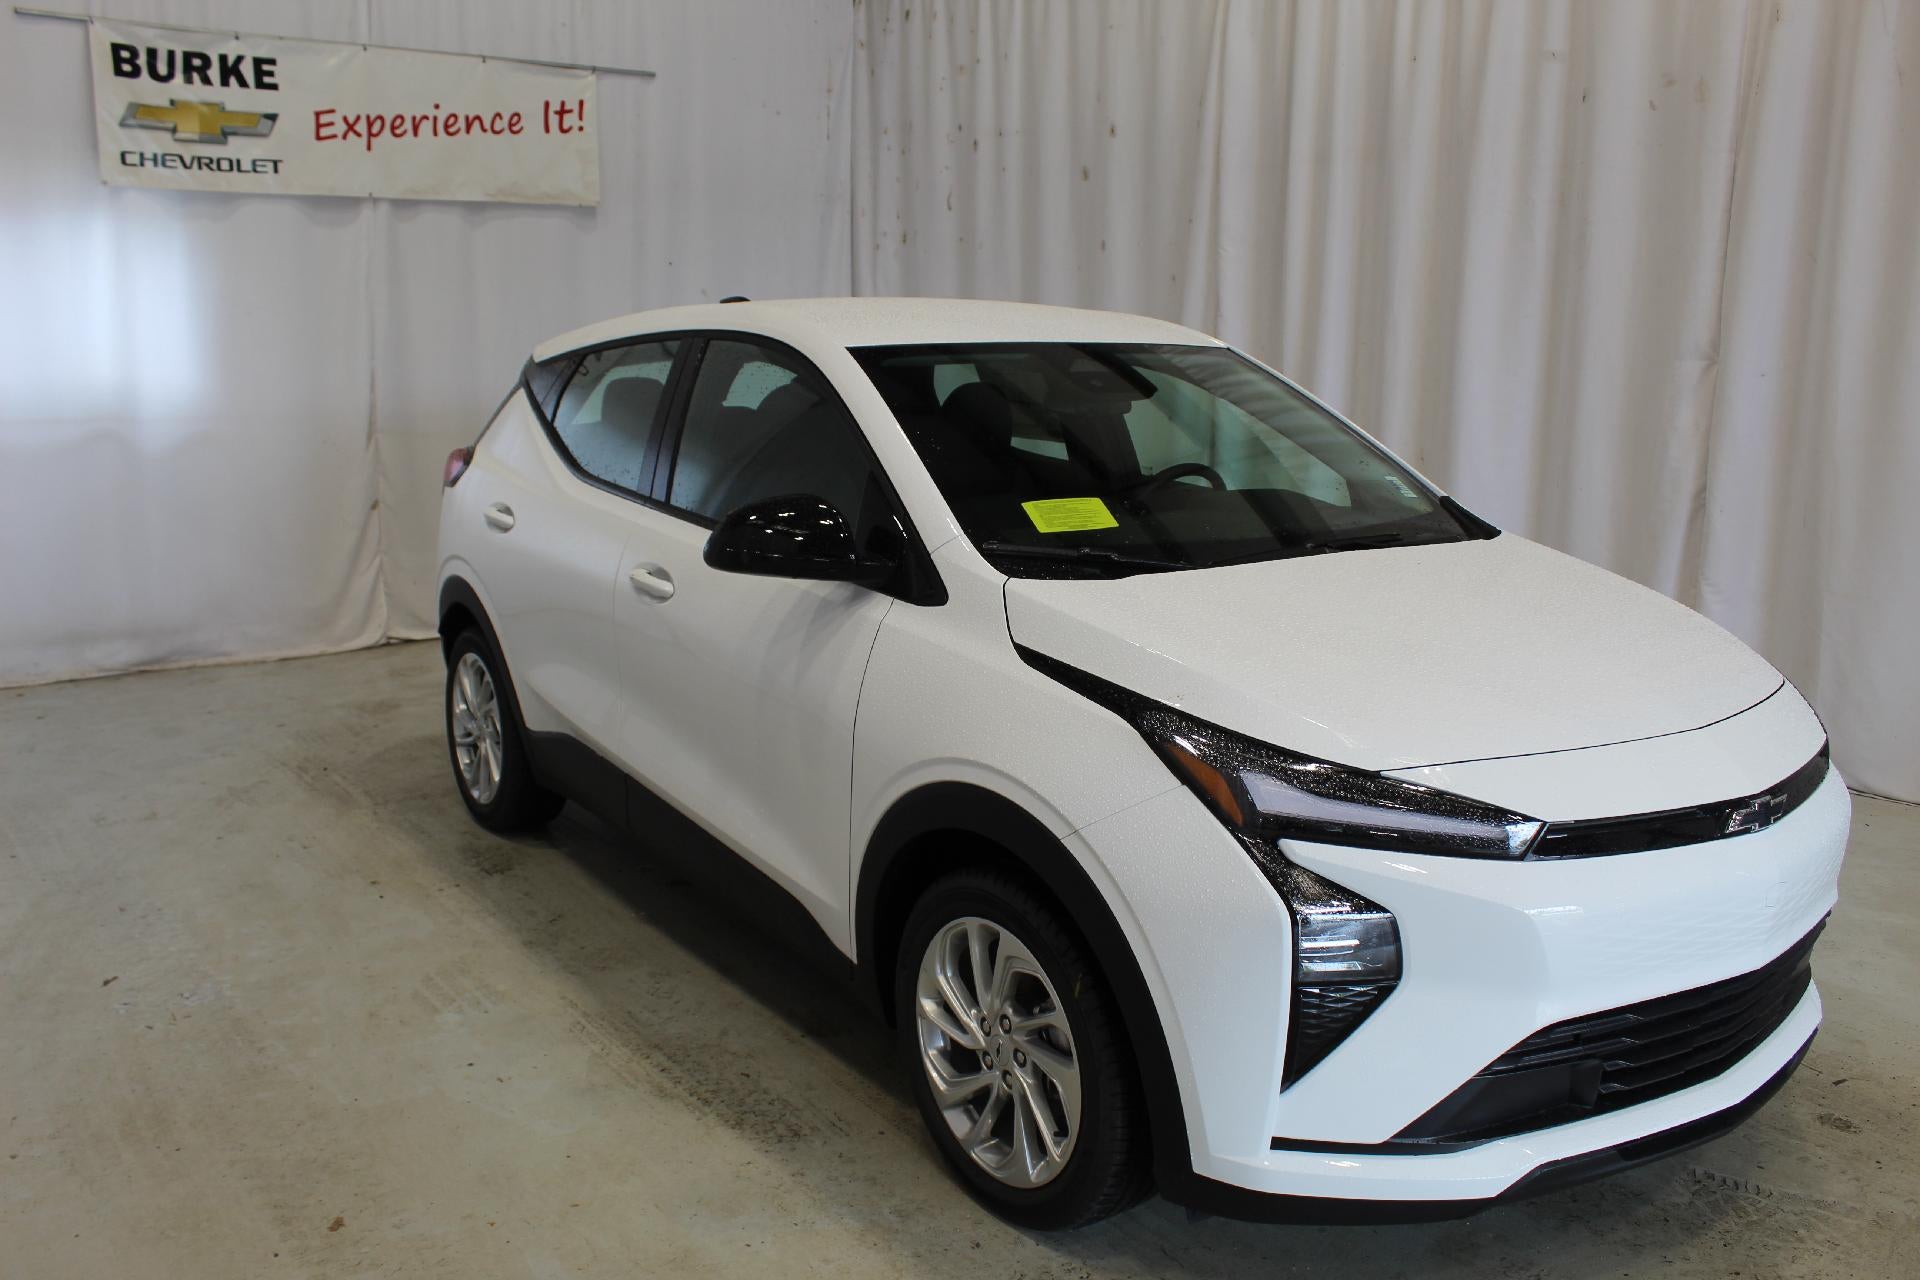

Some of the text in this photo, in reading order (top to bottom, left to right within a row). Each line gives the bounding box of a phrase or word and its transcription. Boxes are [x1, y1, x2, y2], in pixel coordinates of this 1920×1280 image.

[109, 42, 280, 91] BURKE
[313, 99, 586, 152] Experience It!
[119, 150, 284, 175] CHEVROLET
